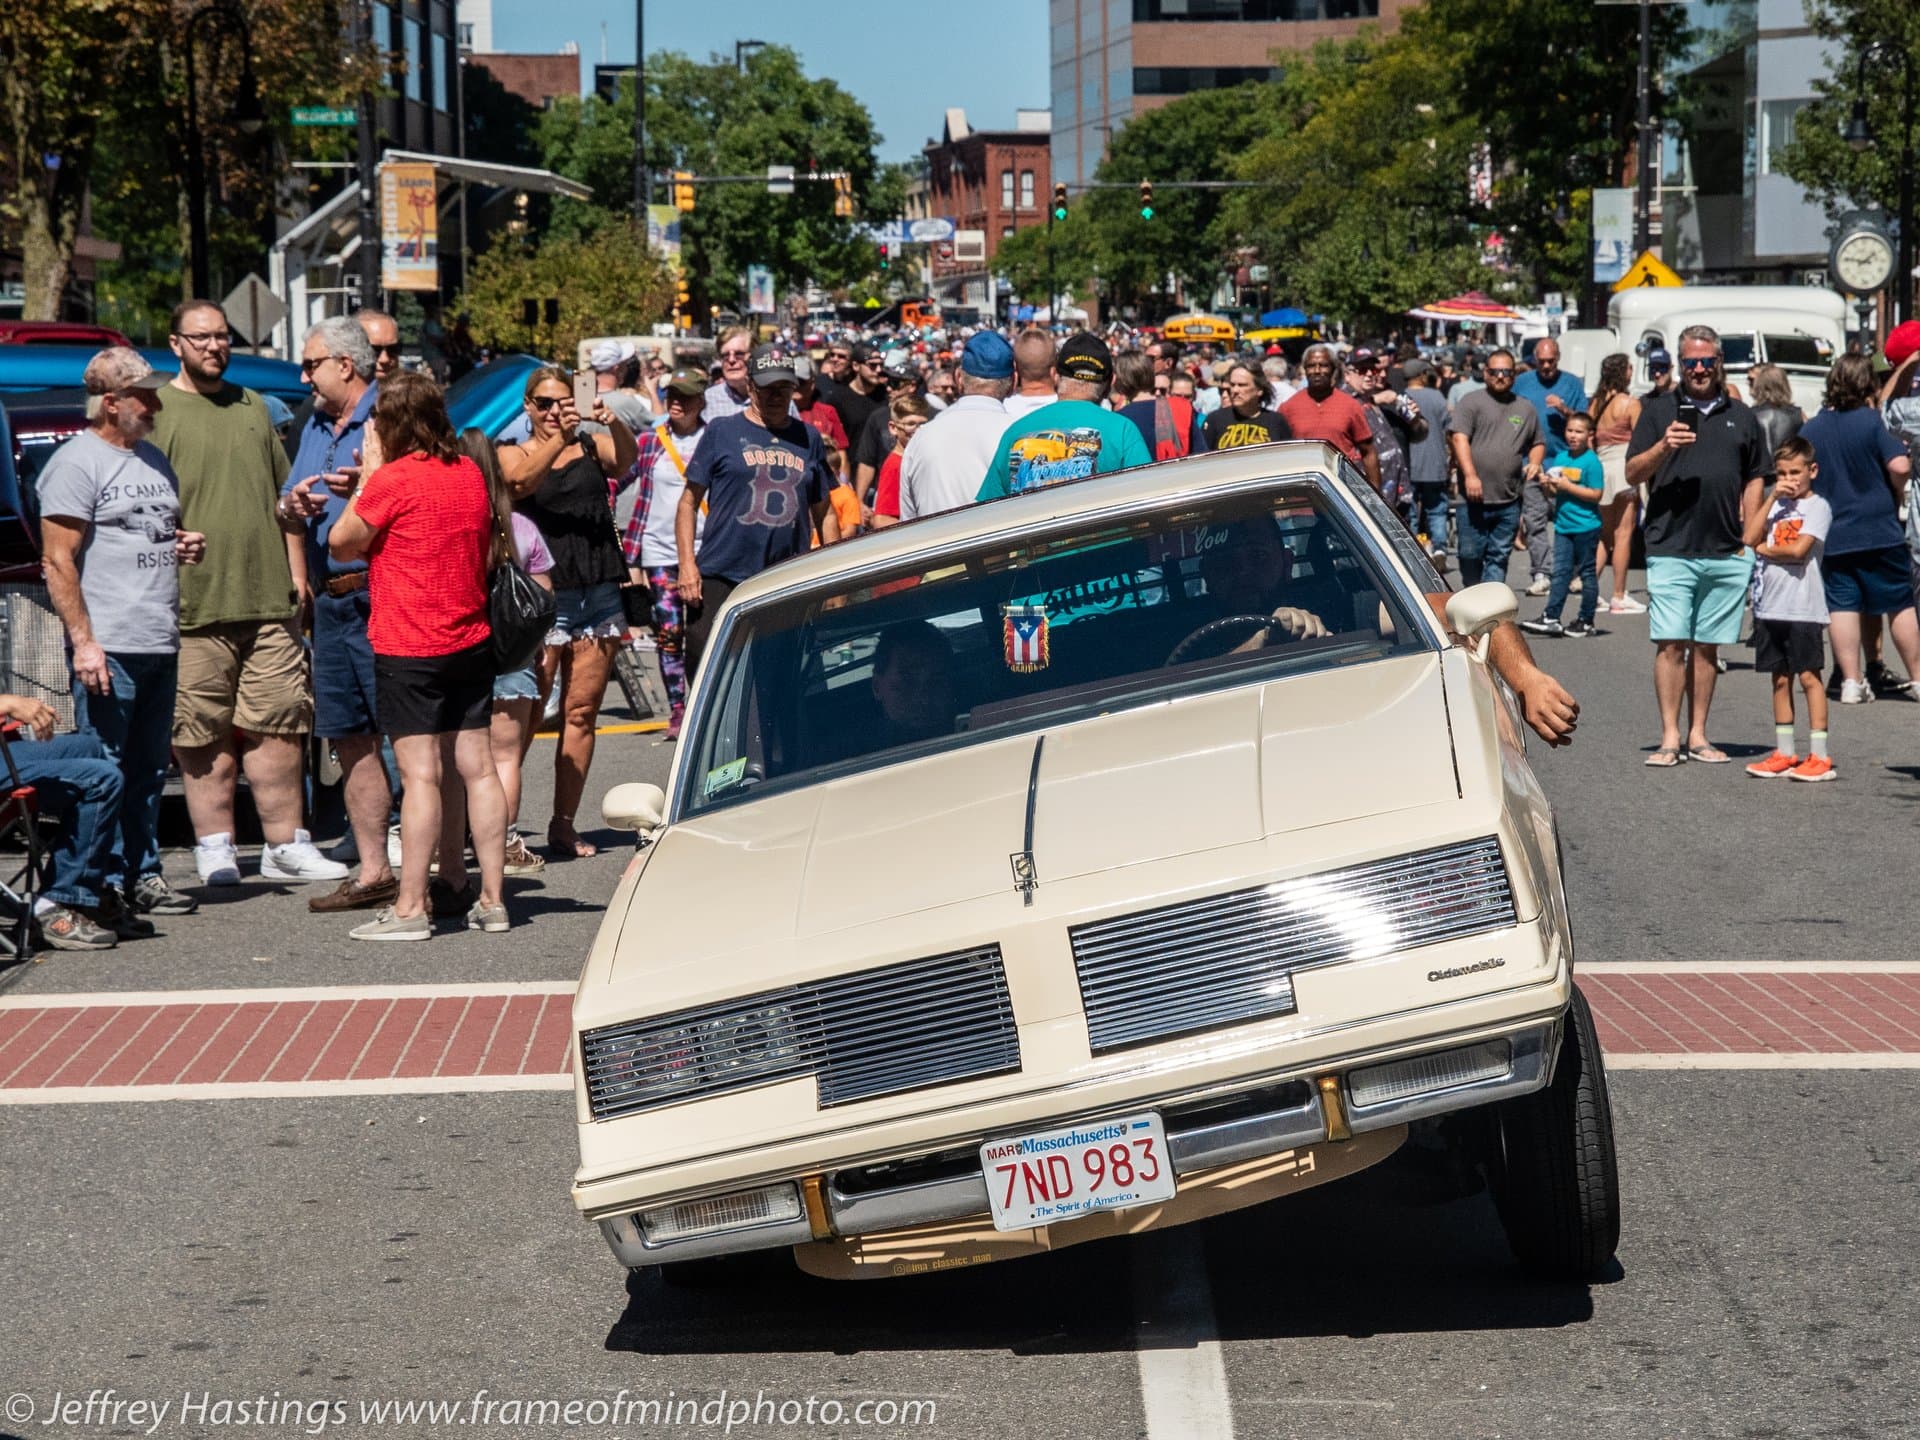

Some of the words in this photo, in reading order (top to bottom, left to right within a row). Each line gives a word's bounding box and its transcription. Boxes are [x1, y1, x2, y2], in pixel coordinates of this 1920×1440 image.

[743, 450, 804, 472] BOSTON
[1427, 958, 1505, 982] Oldsmobile
[986, 1145, 1016, 1160] MAR
[1021, 1126, 1121, 1154] Massachusetts
[995, 1154, 1073, 1209] 7ND
[1083, 1138, 1159, 1192] 983
[1036, 1207, 1054, 1217] The
[1056, 1201, 1080, 1215] Spirit
[1084, 1199, 1092, 1210] of
[1094, 1193, 1133, 1207] America
